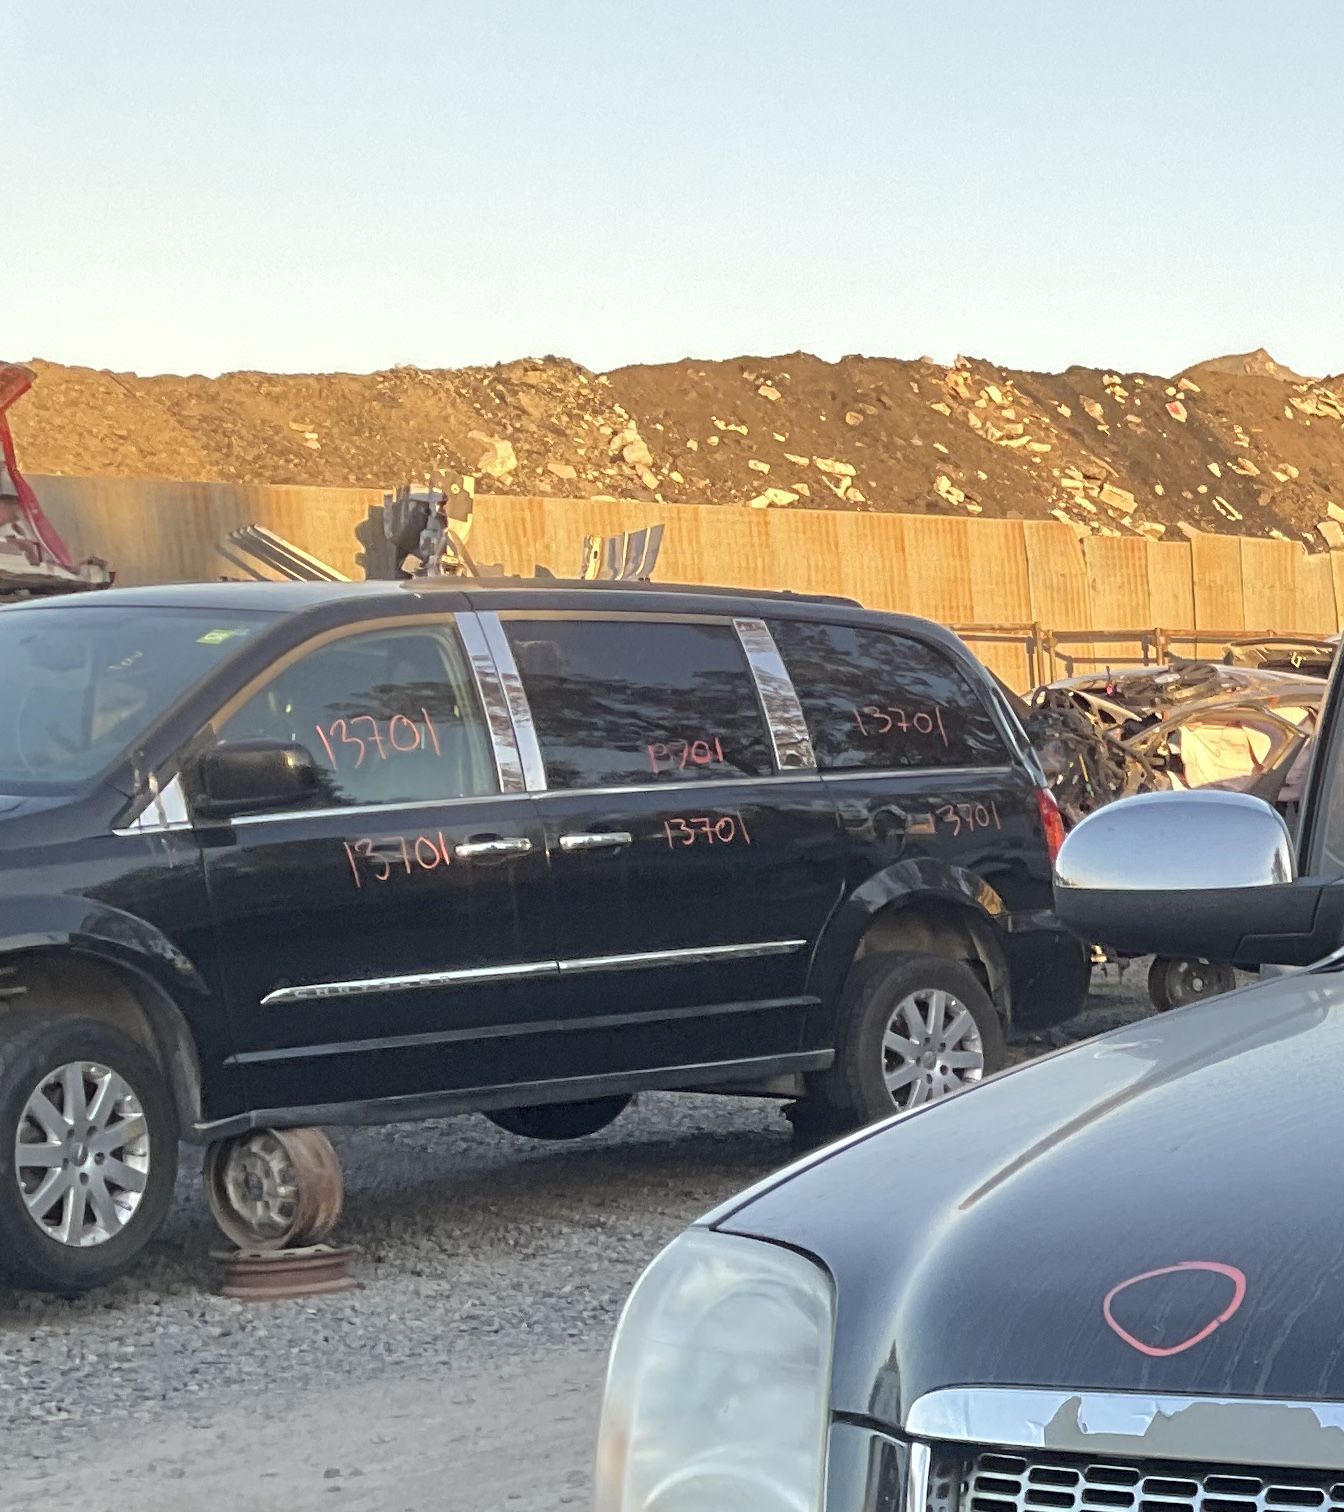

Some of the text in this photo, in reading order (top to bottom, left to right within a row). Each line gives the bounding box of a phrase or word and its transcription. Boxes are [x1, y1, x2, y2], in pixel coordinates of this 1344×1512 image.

[315, 707, 441, 770] 13701
[853, 705, 949, 748] 13701
[663, 810, 751, 849] 13701
[343, 831, 450, 889] 13701
